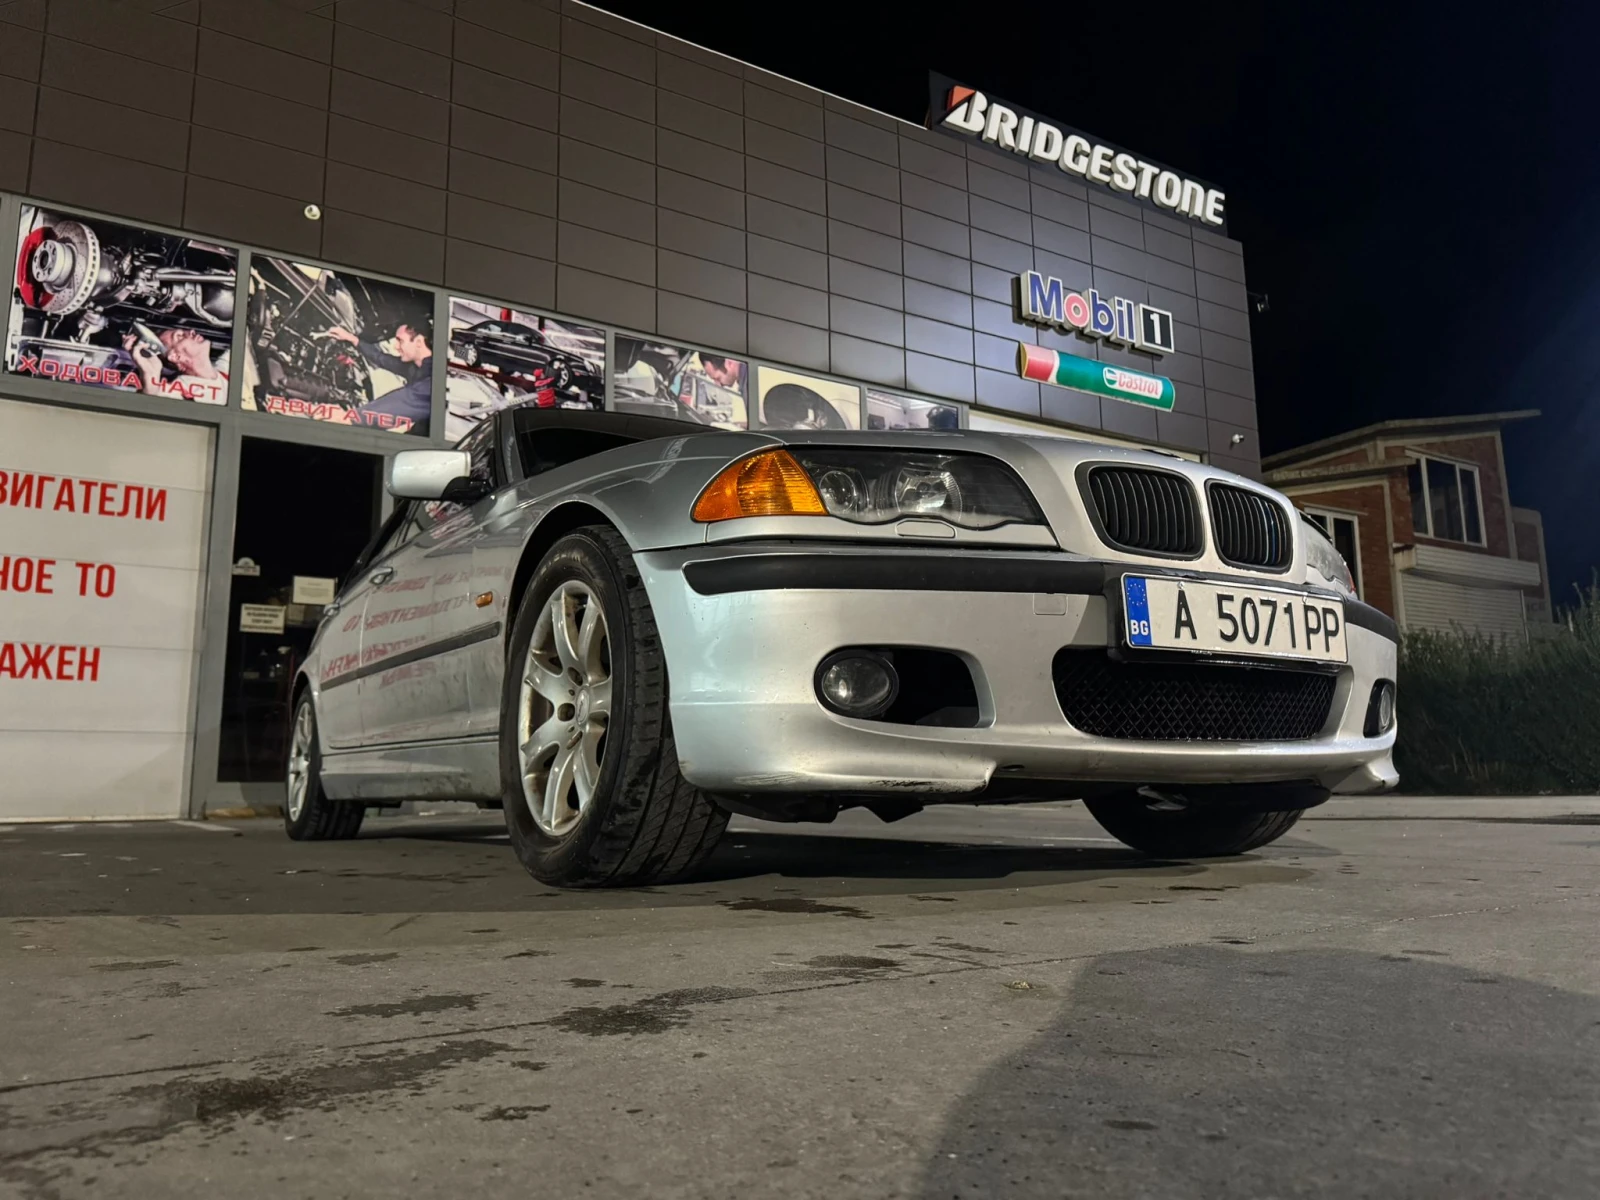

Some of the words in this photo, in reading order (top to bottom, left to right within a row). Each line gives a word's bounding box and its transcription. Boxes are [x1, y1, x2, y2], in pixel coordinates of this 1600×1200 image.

[943, 86, 1226, 226] BRIDGESTONE
[1021, 269, 1136, 344] Mobil
[19, 355, 143, 390] ХОДОВА
[150, 376, 222, 401] ЧАСТ
[1117, 372, 1159, 396] Castrol
[267, 395, 413, 431] ДВИГАТЕЛ
[75, 561, 116, 599] ТО
[1130, 619, 1150, 636] BG
[1174, 589, 1197, 640] A
[0, 642, 101, 682] АЖЕН
